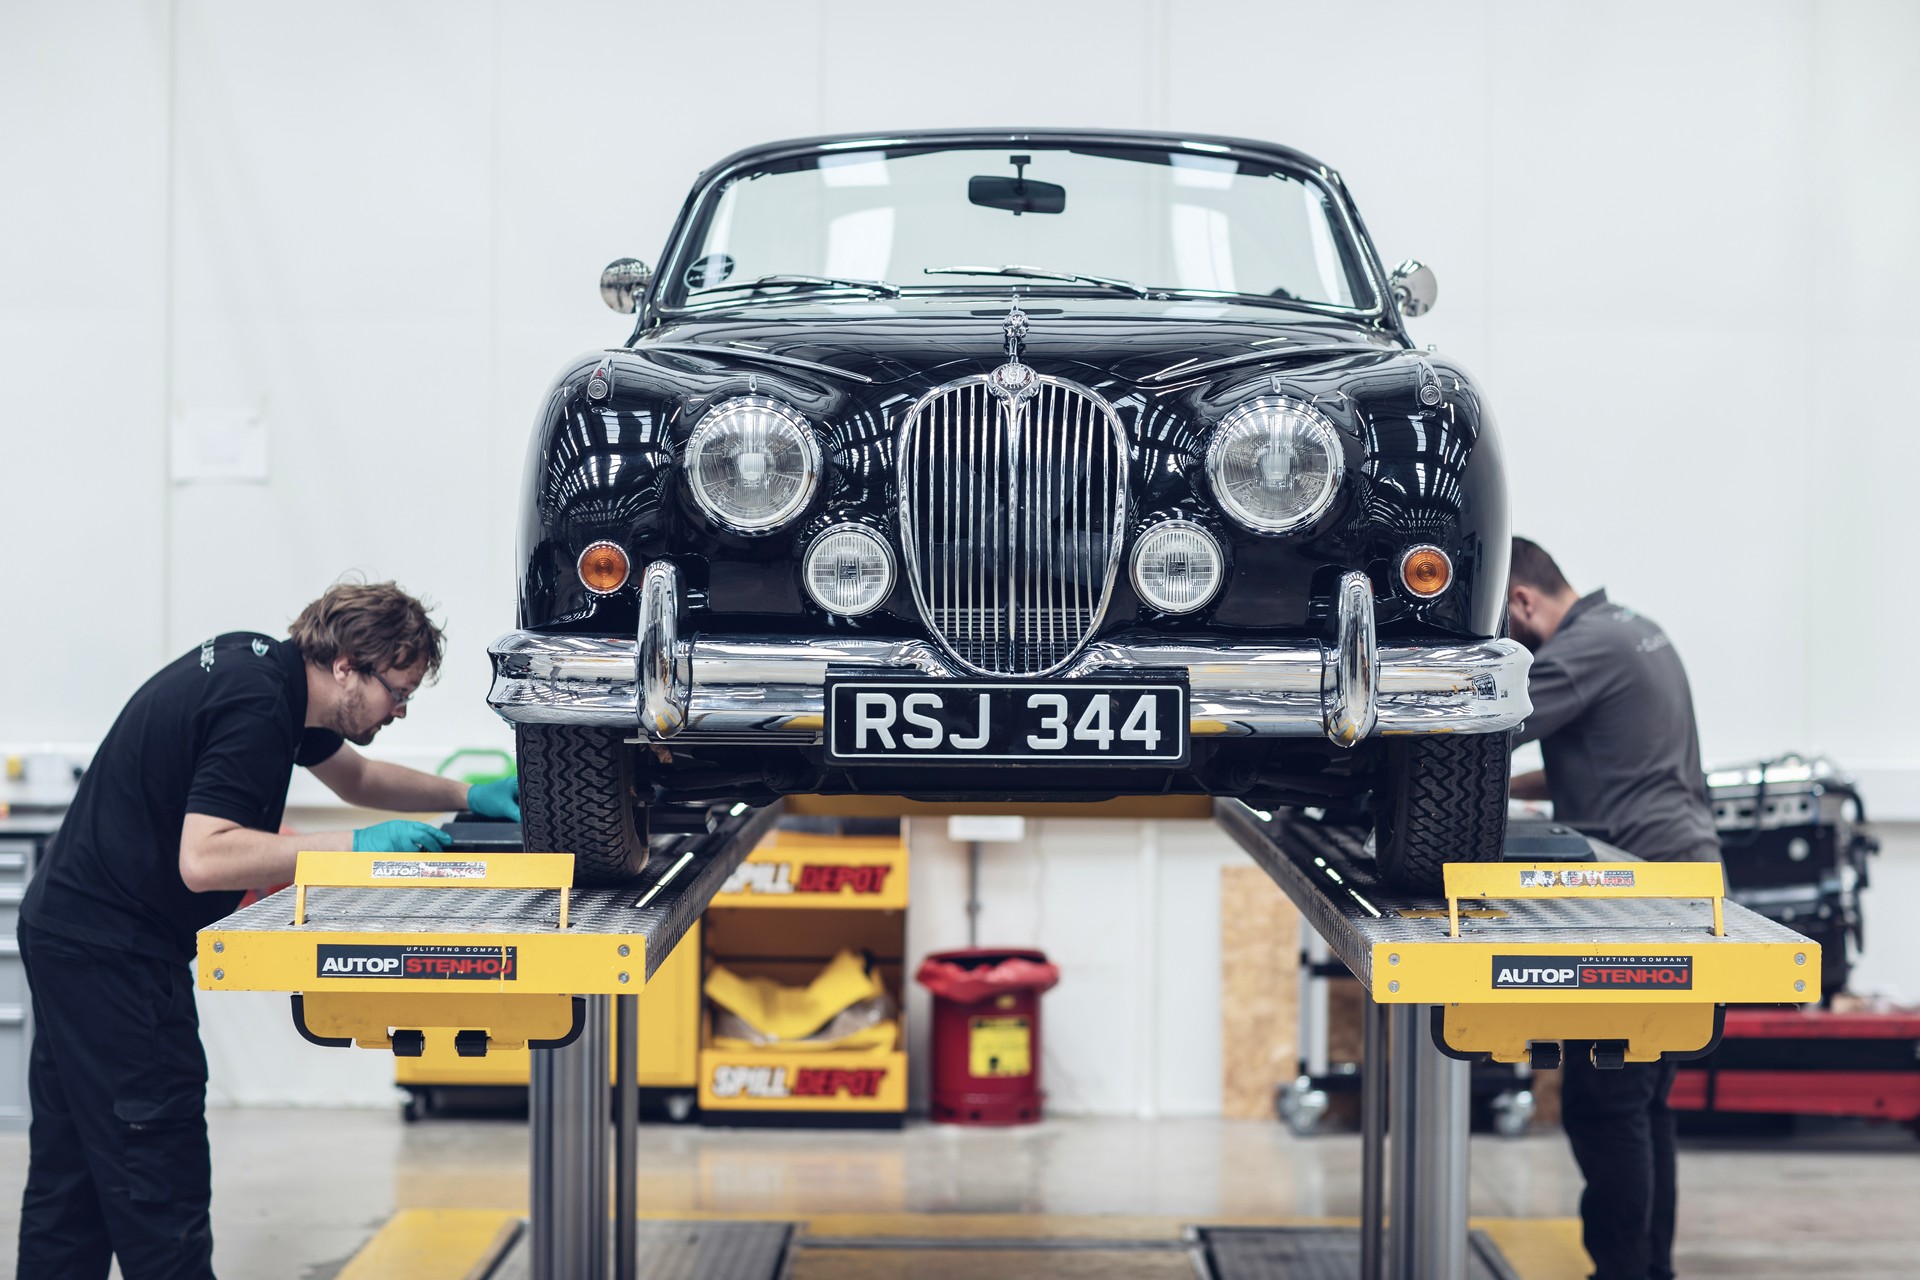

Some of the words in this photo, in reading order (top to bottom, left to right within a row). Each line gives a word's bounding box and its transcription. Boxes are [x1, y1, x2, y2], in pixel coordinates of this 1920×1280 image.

[855, 692, 991, 749] RSJ
[1026, 693, 1161, 750] 344
[799, 863, 892, 894] DEPOT
[322, 957, 399, 973] AUTOP
[406, 957, 512, 974] STENHOJ
[1497, 968, 1574, 983] AUTOP
[1581, 969, 1688, 984] STENHOJ
[712, 1065, 791, 1097] SPILL
[794, 1067, 888, 1097] DEPOT
